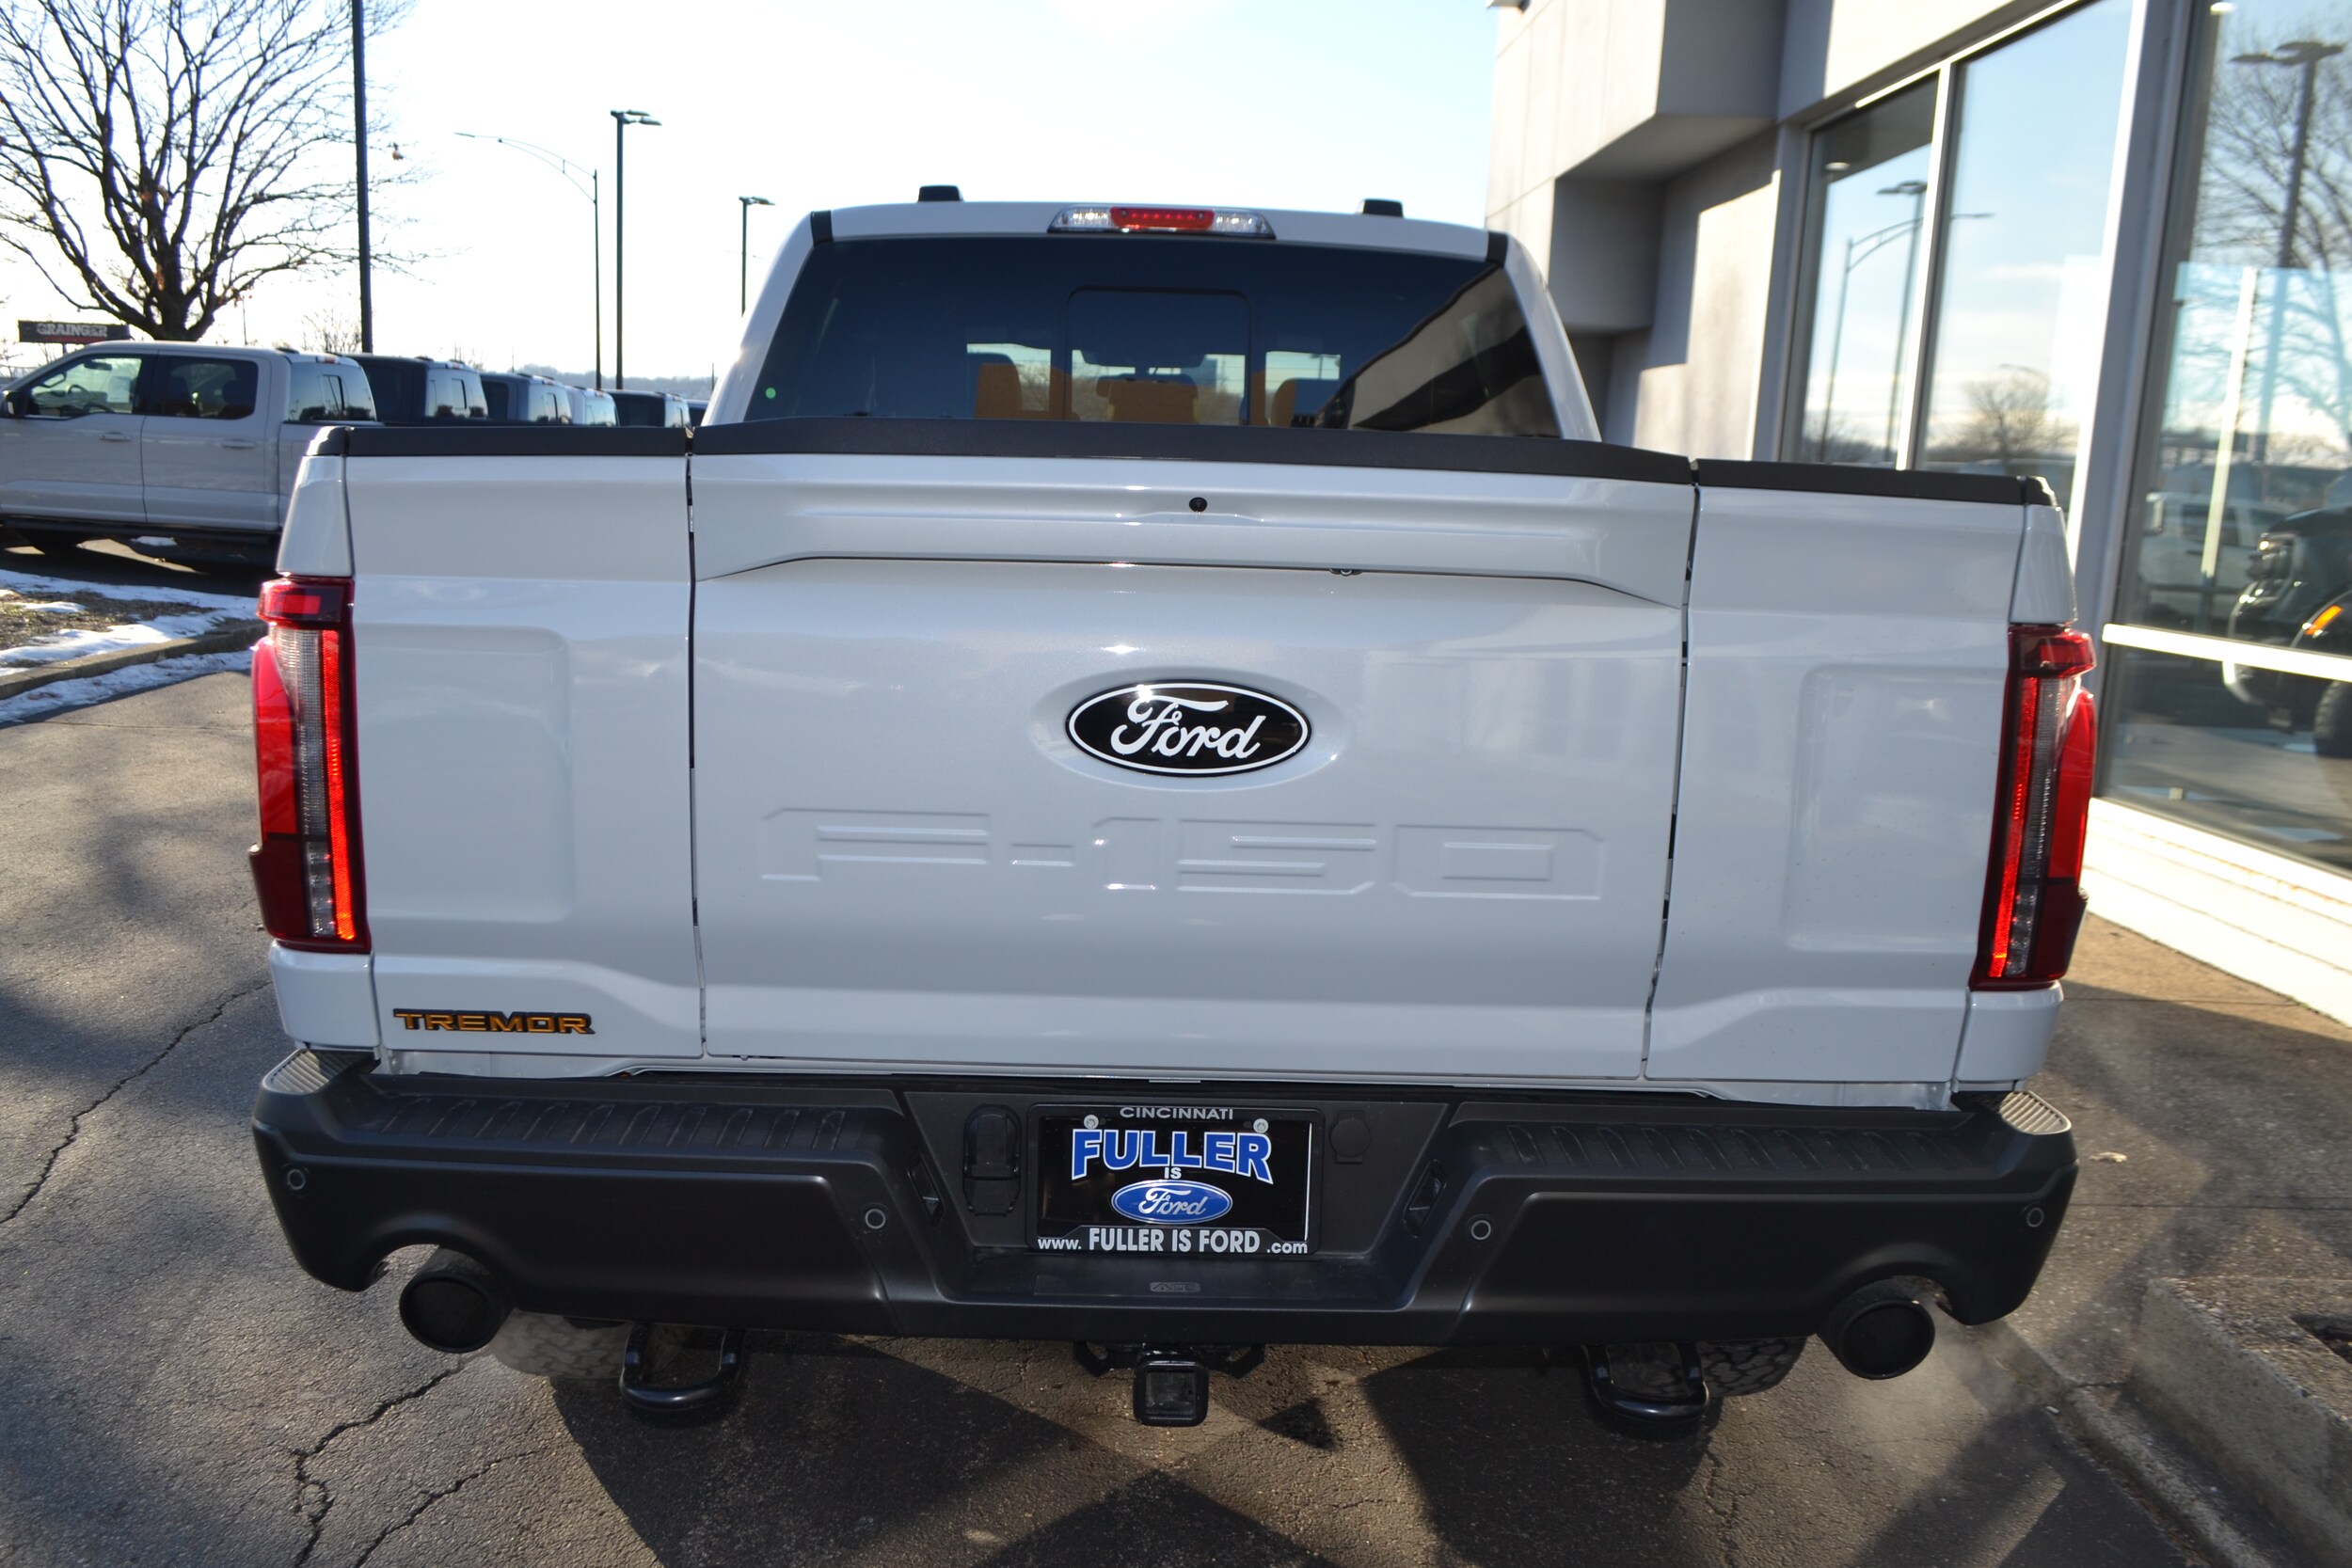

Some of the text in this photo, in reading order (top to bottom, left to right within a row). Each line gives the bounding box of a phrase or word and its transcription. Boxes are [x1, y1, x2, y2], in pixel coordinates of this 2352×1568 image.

[37, 323, 108, 337] GRAINGER
[1111, 694, 1266, 758] Ford
[761, 807, 1604, 900] F-150
[392, 1007, 596, 1035] TREMOR
[1120, 1106, 1233, 1119] CINCINNATI
[1071, 1128, 1274, 1185] FULLER
[1164, 1167, 1182, 1180] IS
[1138, 1187, 1208, 1215] Ford
[1037, 1227, 1309, 1255] www. FULLER IS FORD .com
